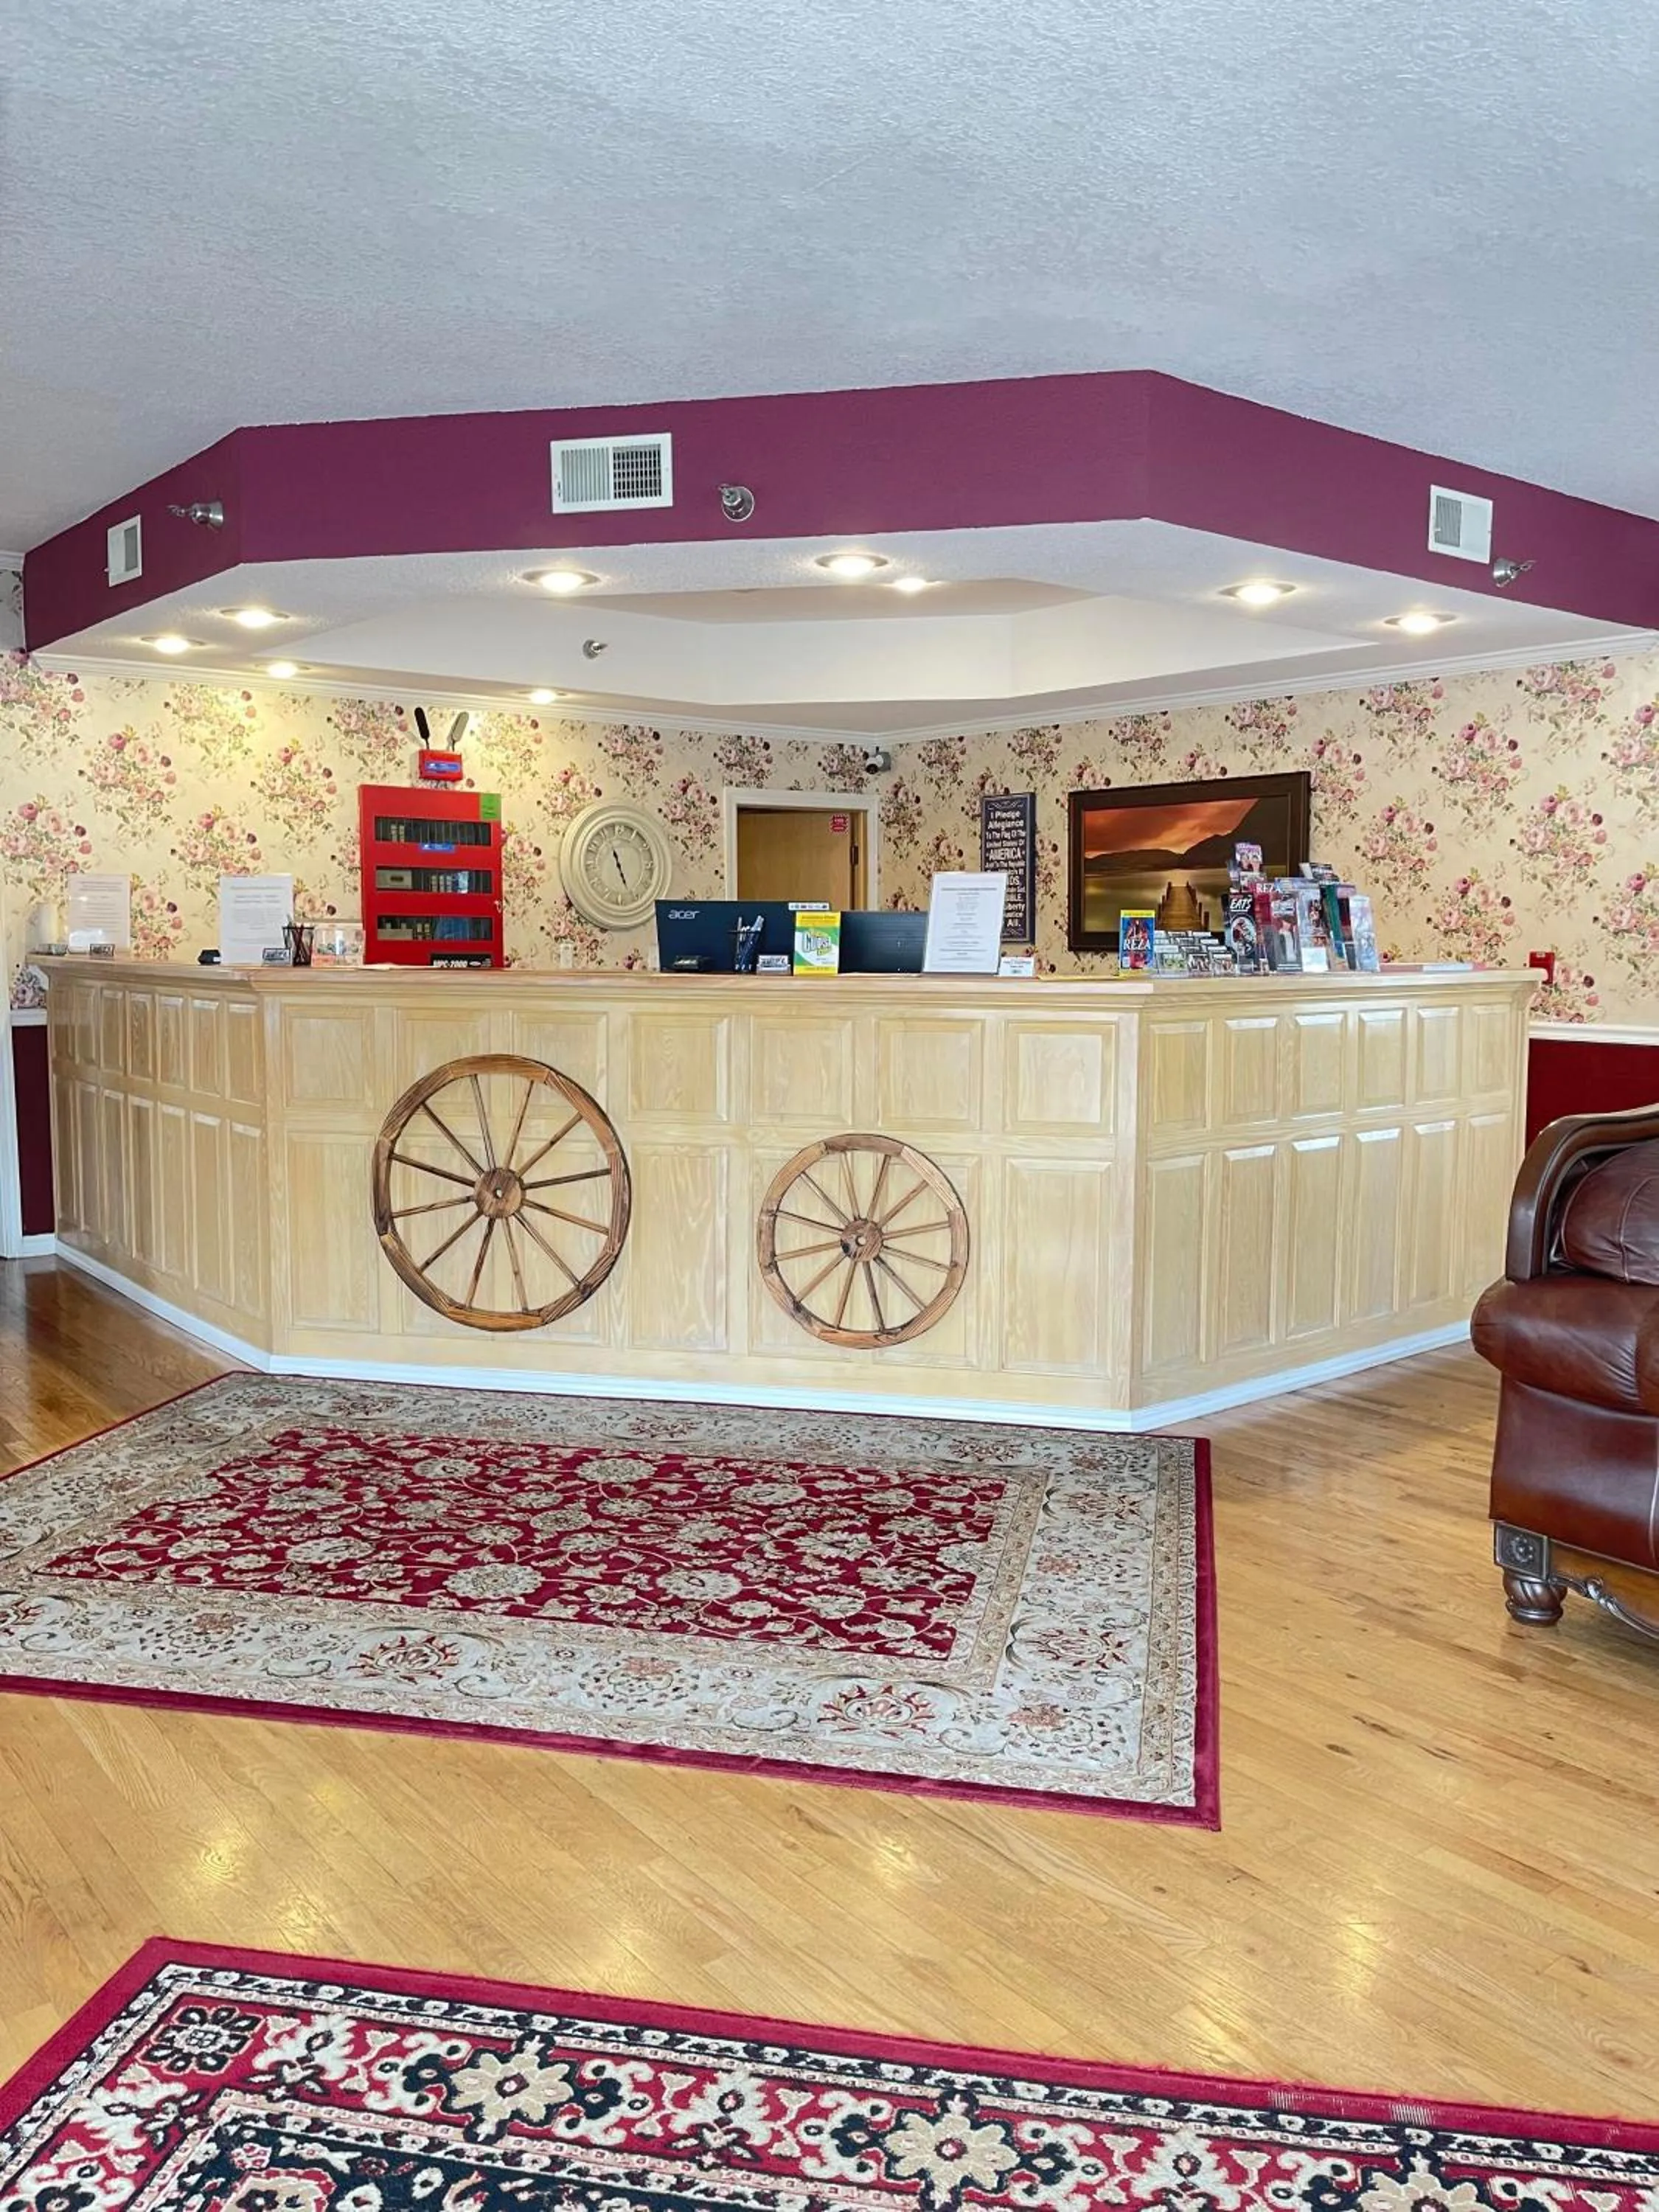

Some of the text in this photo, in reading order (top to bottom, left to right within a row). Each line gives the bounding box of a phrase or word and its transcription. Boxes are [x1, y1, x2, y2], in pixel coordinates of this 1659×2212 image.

[995, 810, 1021, 819] Pledge
[987, 819, 1024, 831] Allegiance
[989, 847, 1022, 861] AMERICA
[1229, 894, 1253, 909] EATS
[668, 909, 700, 919] acer
[1123, 939, 1151, 950] REZA
